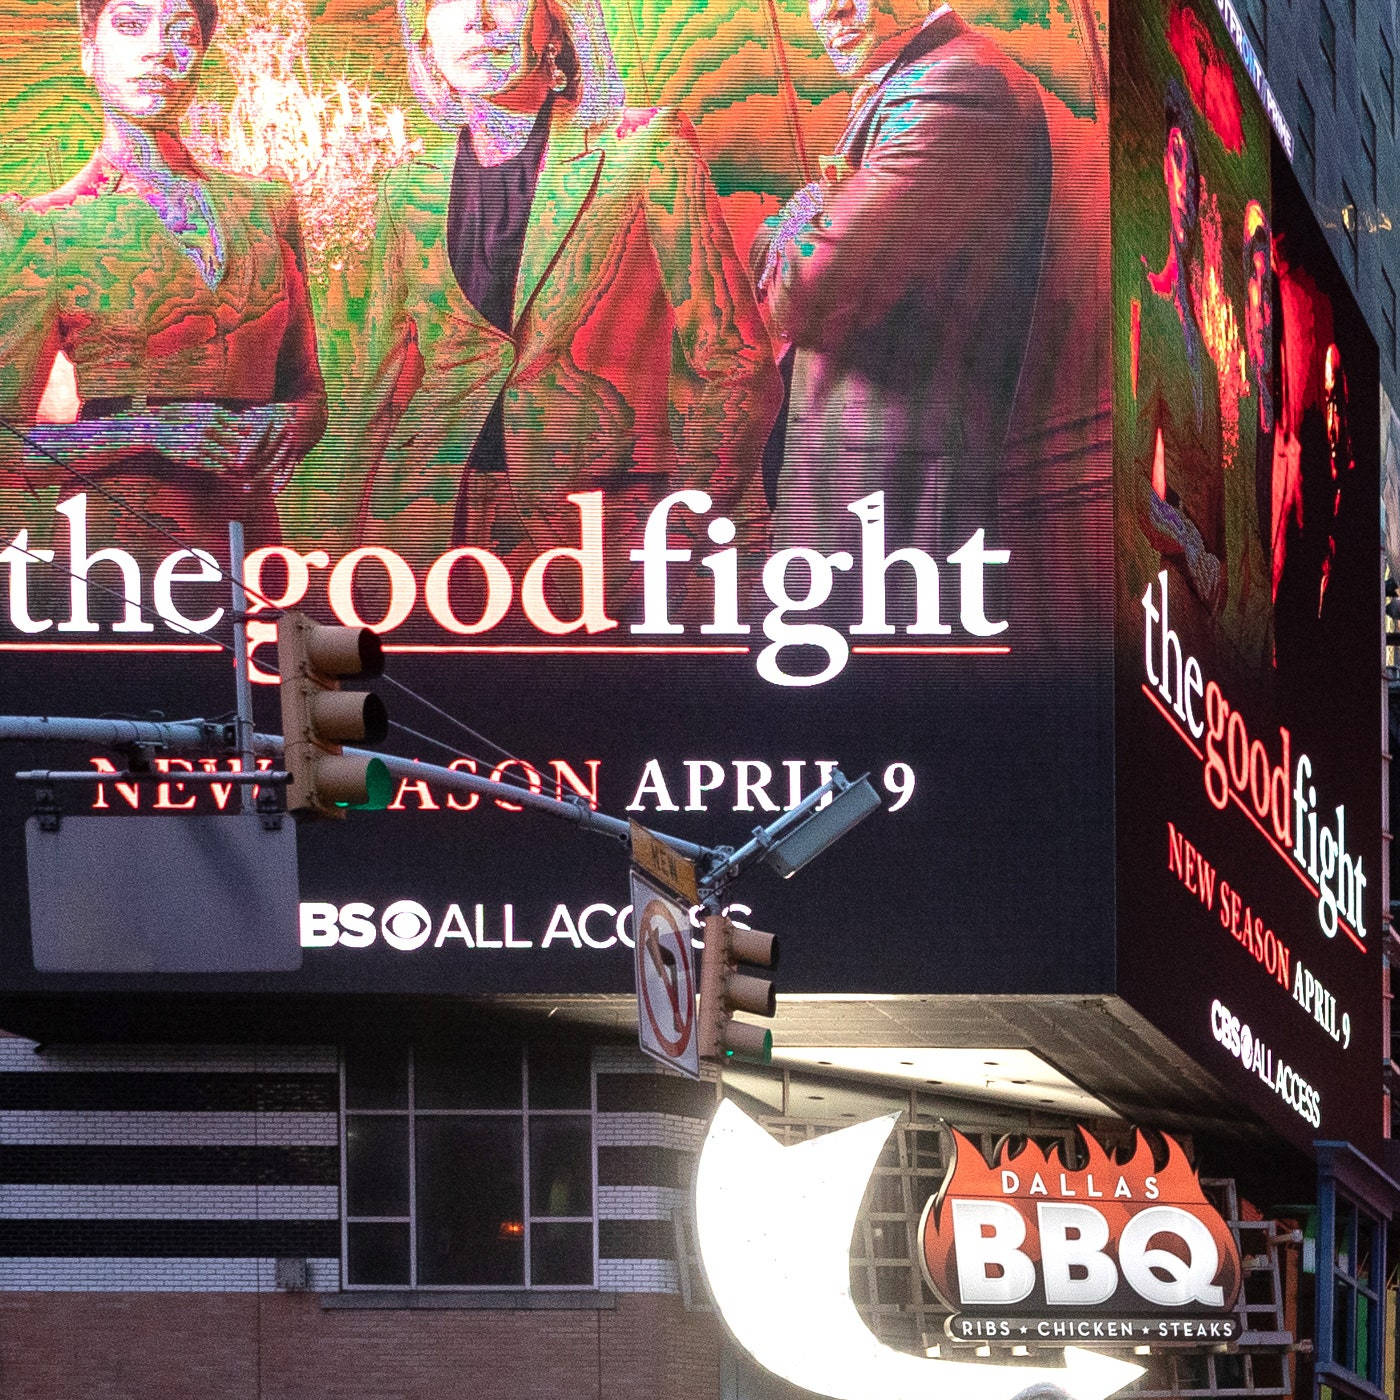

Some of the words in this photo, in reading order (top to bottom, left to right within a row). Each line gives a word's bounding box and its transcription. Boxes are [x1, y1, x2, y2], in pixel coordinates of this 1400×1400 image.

[883, 762, 916, 811] 9
[1142, 570, 1204, 741] the
[1293, 754, 1367, 939] fight
[299, 902, 376, 949] BS
[435, 904, 531, 948] ALL
[542, 904, 752, 948] ACCSS
[1167, 822, 1215, 912] NEW
[1220, 888, 1291, 992] SEASON
[1292, 961, 1342, 1042] APRIL
[1342, 1008, 1351, 1049] 9
[1211, 999, 1242, 1058] CBS
[1252, 1035, 1276, 1092] ALL
[1275, 1054, 1322, 1129] ACCESS
[1001, 1170, 1161, 1200] DALLAS
[951, 1199, 1225, 1307] BBQ
[961, 1320, 1011, 1337] RIBS
[1037, 1320, 1134, 1338] CHICKEN
[1158, 1321, 1234, 1338] STEAKS
